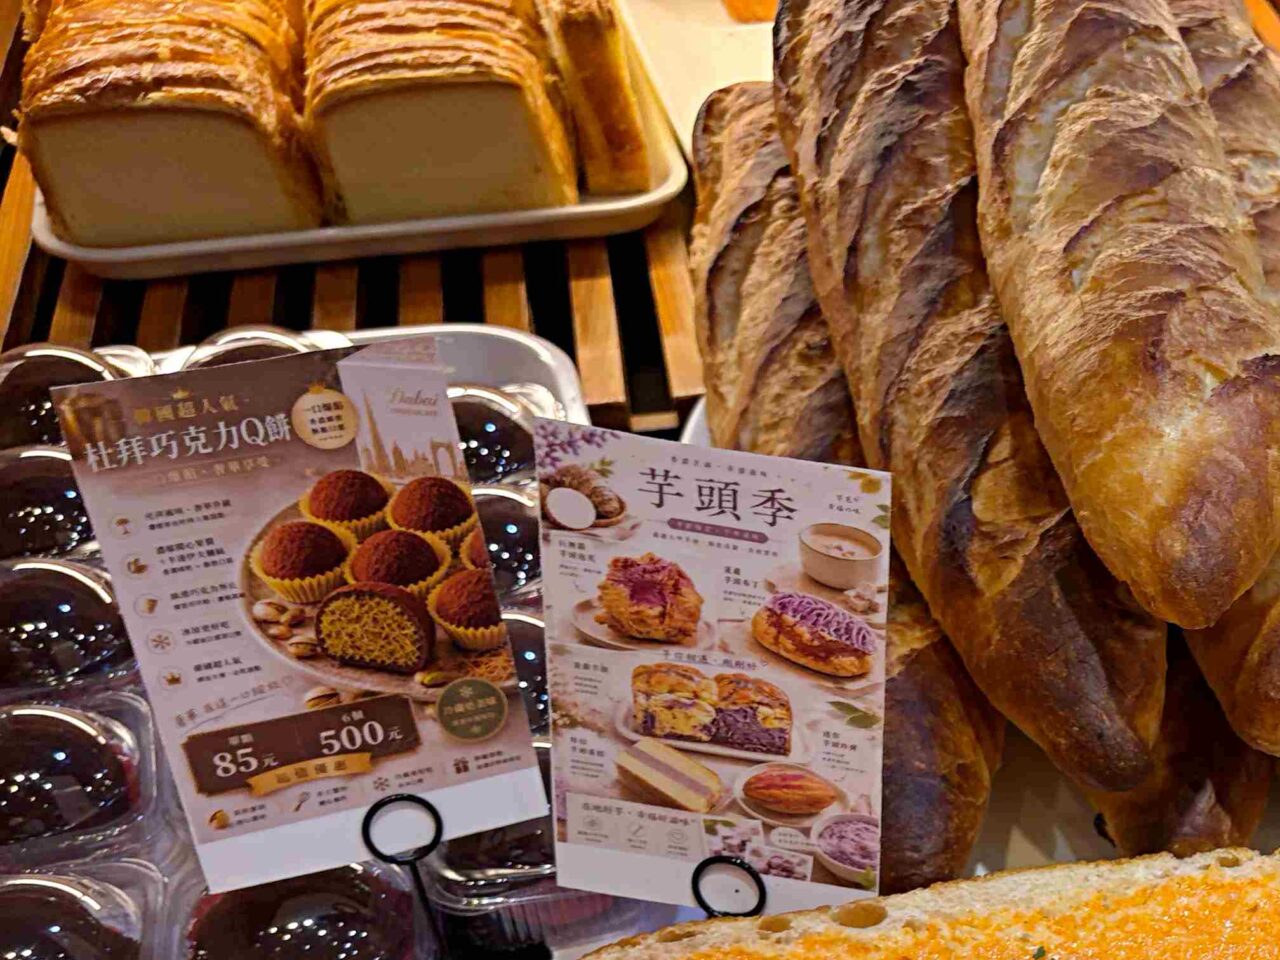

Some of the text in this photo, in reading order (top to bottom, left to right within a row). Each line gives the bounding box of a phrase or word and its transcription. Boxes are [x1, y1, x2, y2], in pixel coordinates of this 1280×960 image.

[84, 412, 291, 472] 杜拜巧克力Q餅
[637, 466, 799, 528] 芋頭季
